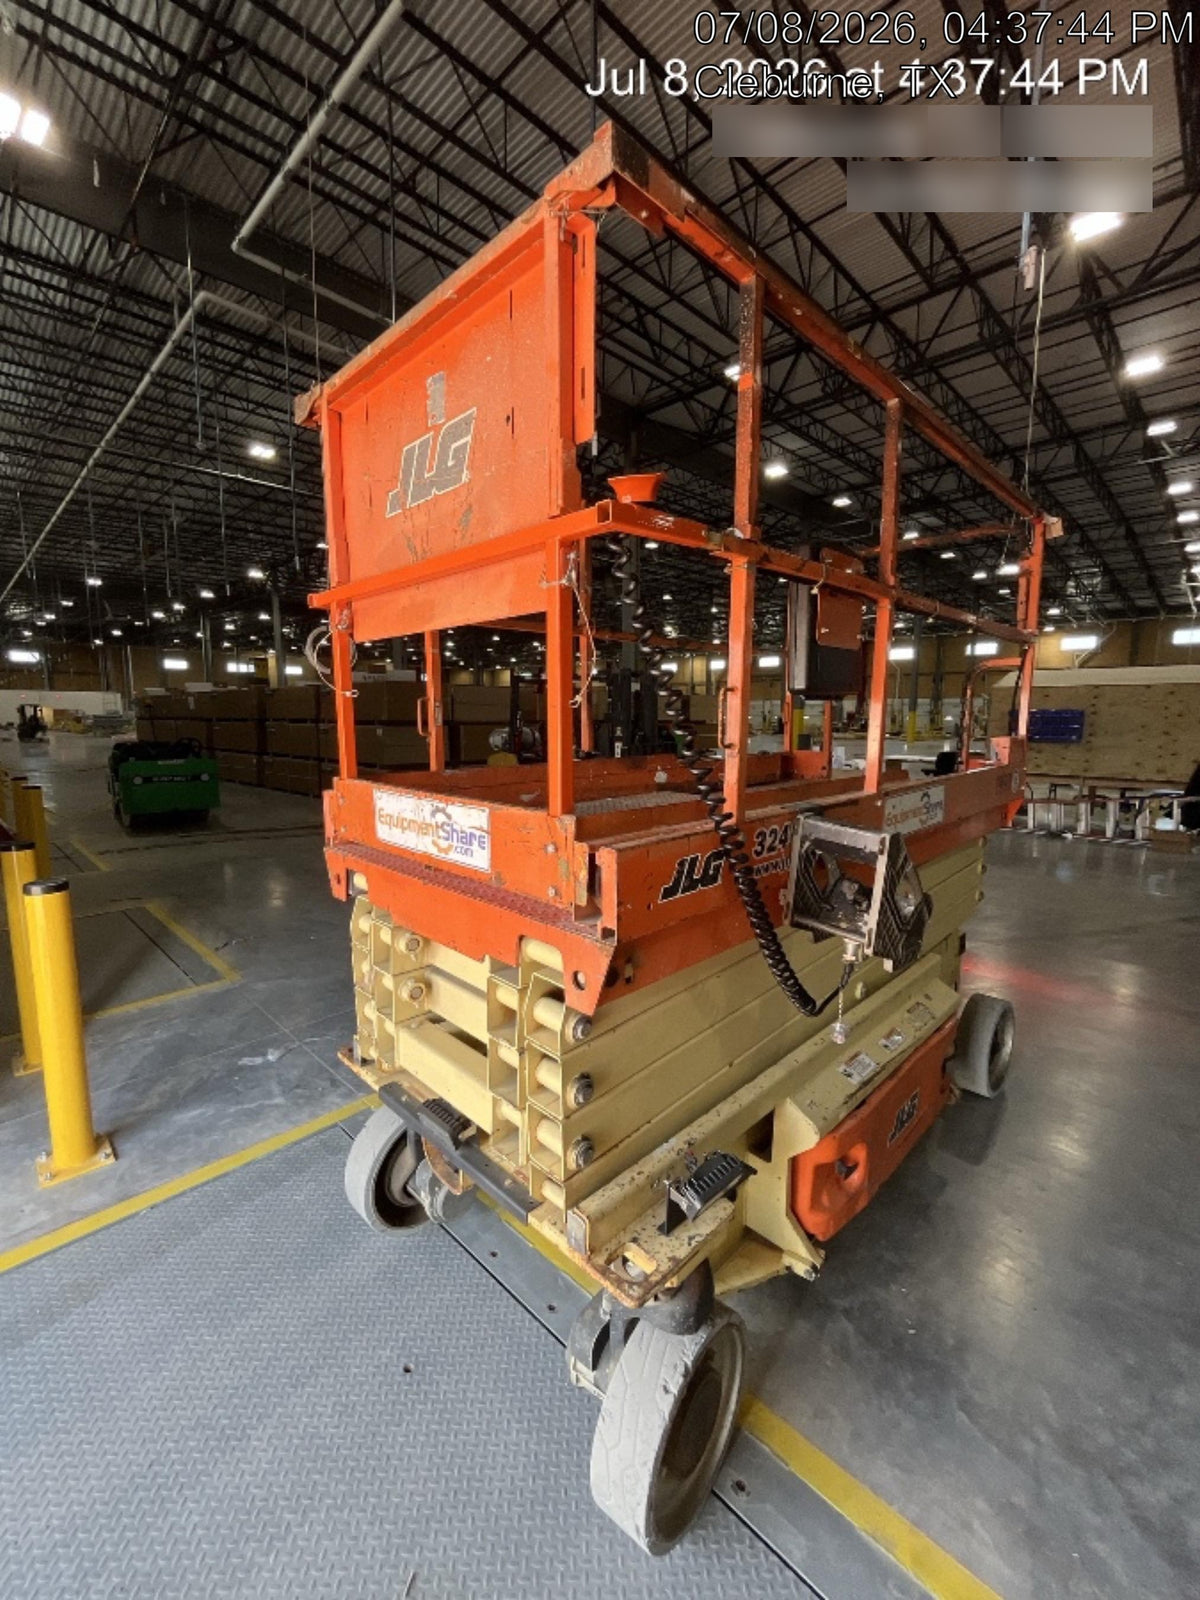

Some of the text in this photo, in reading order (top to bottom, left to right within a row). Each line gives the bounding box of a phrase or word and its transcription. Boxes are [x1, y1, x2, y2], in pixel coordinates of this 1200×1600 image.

[385, 406, 478, 519] JLG
[377, 806, 487, 851] EquipmentShare
[657, 846, 728, 904] JLG
